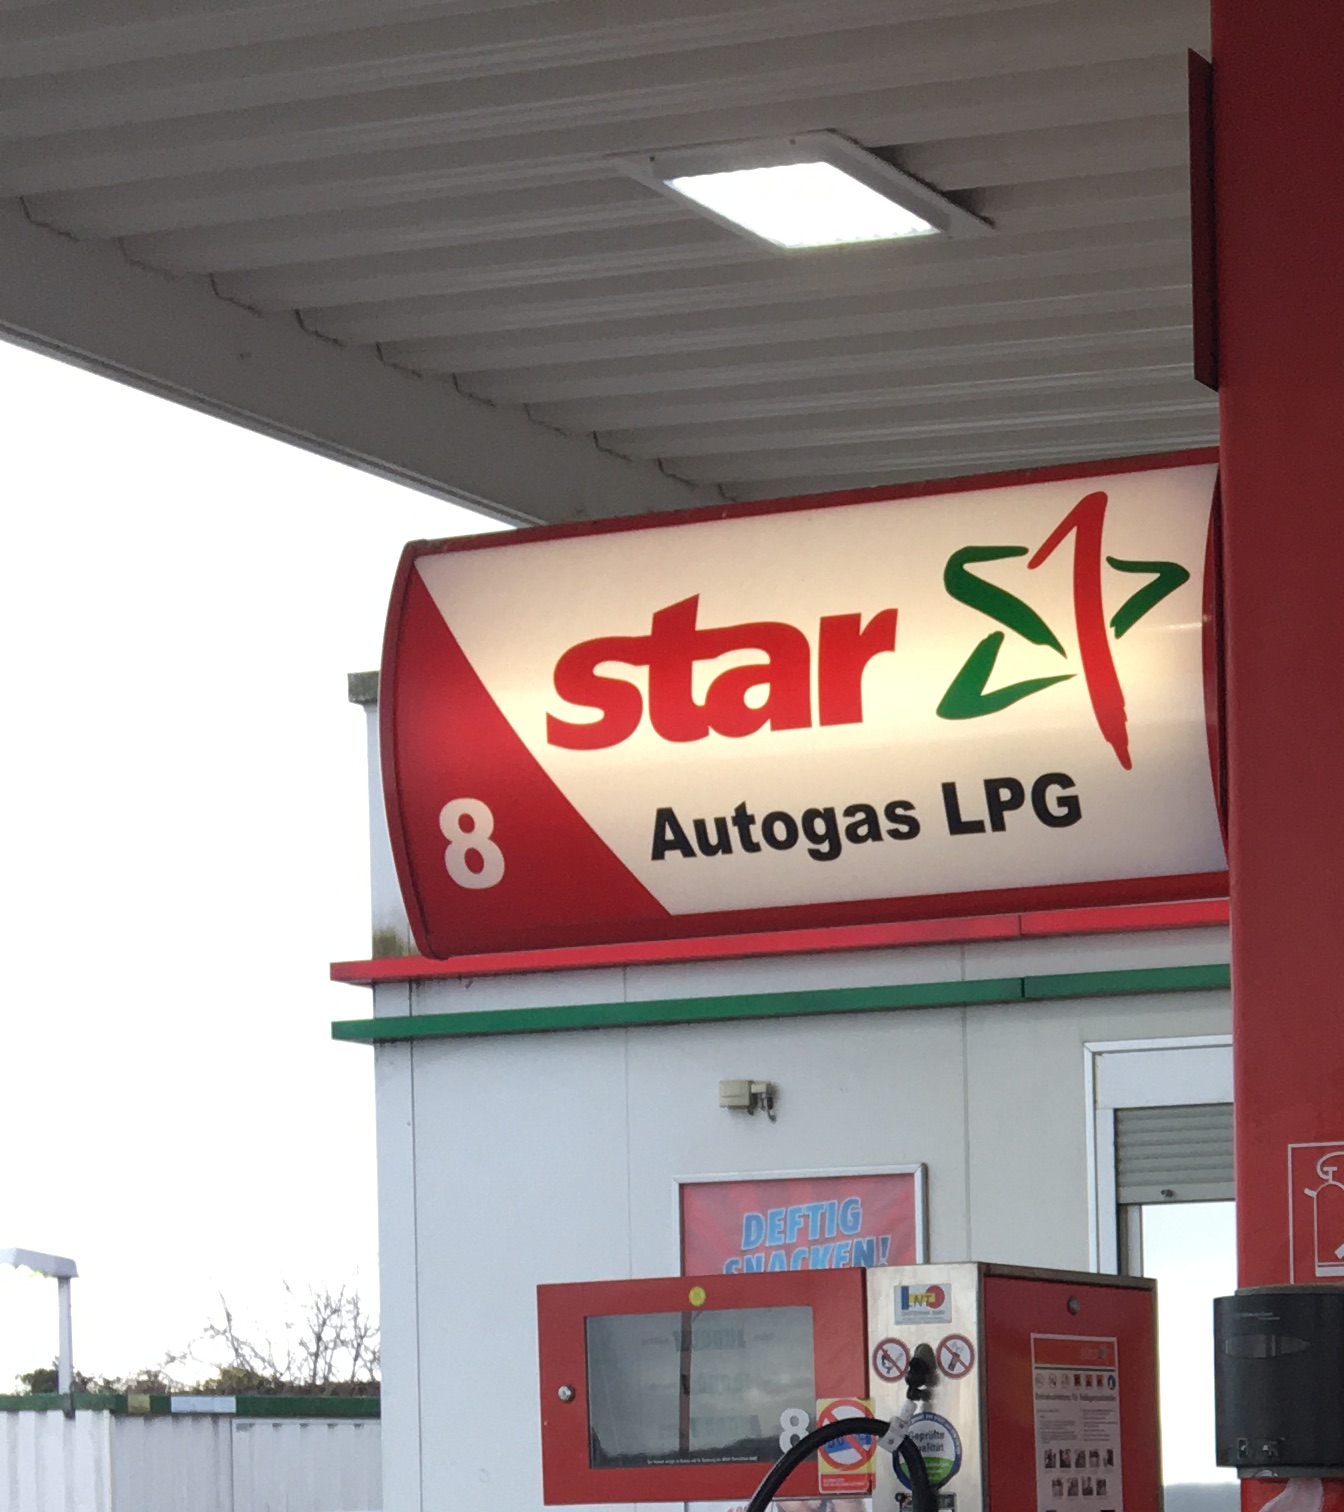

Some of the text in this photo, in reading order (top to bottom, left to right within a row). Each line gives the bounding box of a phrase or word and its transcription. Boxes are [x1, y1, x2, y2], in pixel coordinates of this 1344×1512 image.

[544, 592, 900, 751] star
[437, 796, 507, 890] 8
[649, 772, 1084, 863] Autogas LPG
[741, 1196, 863, 1251] DEFTIG
[779, 1408, 811, 1456] 8
[918, 1443, 945, 1453] ualität
